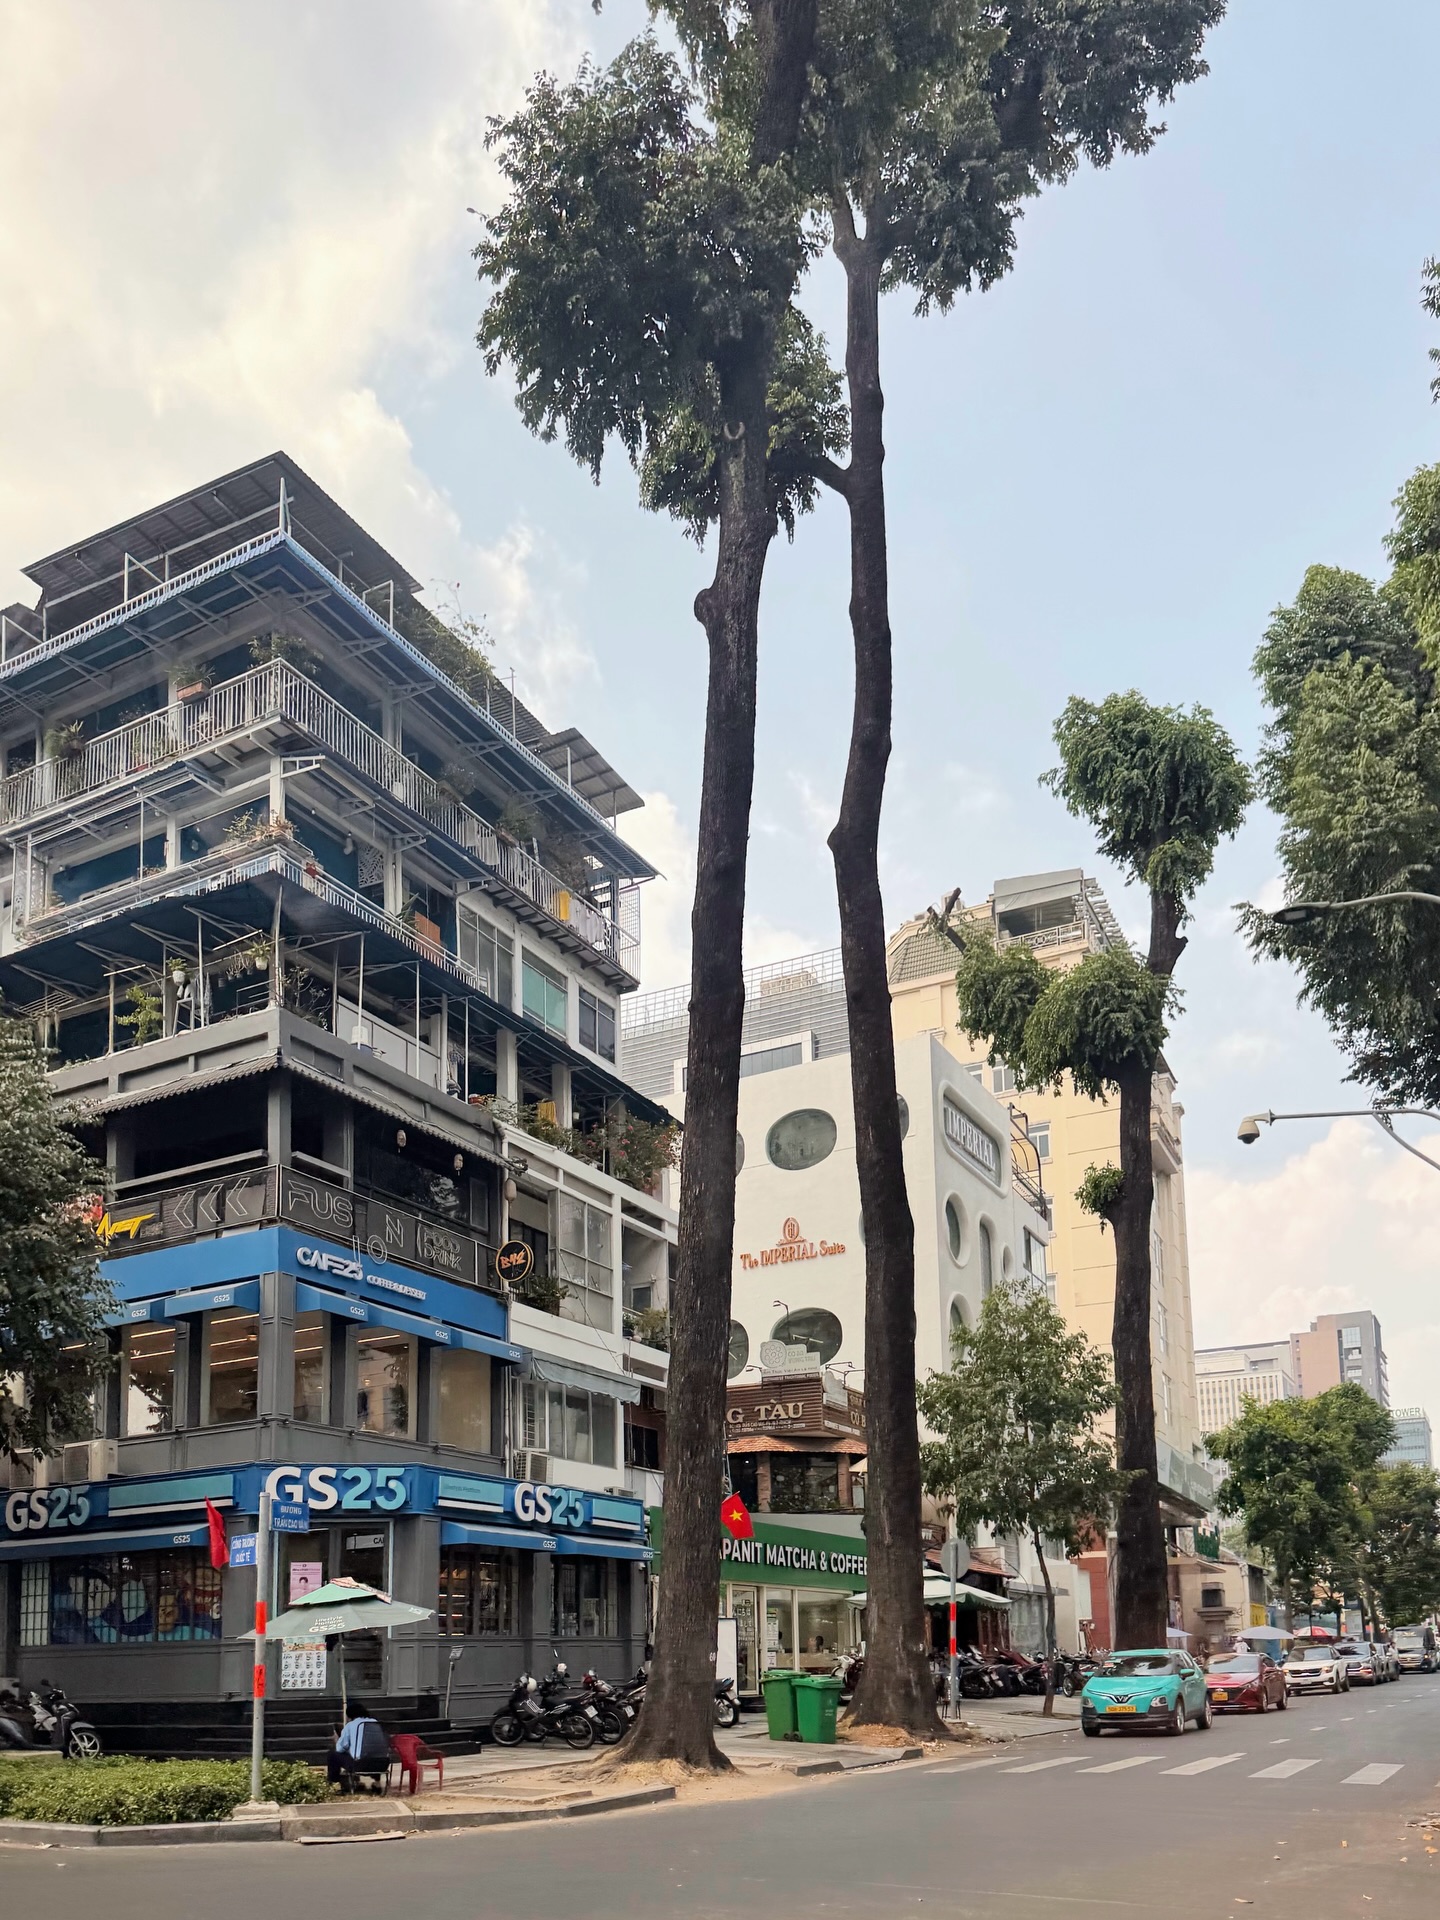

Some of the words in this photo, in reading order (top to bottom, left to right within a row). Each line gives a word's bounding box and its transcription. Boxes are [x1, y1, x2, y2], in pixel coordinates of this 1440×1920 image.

[946, 1106, 996, 1171] IMPERIAL
[424, 1227, 460, 1254] FOOD
[424, 1242, 462, 1271] DRINK
[740, 1252, 759, 1270] The
[760, 1242, 818, 1266] IMPERIAL
[819, 1240, 846, 1262] Suite
[213, 1294, 230, 1304] GS25
[131, 1308, 147, 1318] GS25
[350, 1306, 365, 1316] GS25
[435, 1329, 449, 1339] GS25
[754, 1399, 804, 1420] TÀU
[1393, 1407, 1421, 1417] TOWER
[266, 1466, 406, 1510] GS25
[5, 1485, 90, 1532] GS25
[514, 1482, 584, 1528] GS25
[173, 1534, 191, 1544] GS25
[543, 1540, 557, 1549] GS25
[642, 1550, 654, 1558] GS25
[718, 1538, 762, 1563] PANIT
[767, 1544, 817, 1570] MATCHA
[820, 1551, 827, 1571] &
[308, 1623, 346, 1633] GS25
